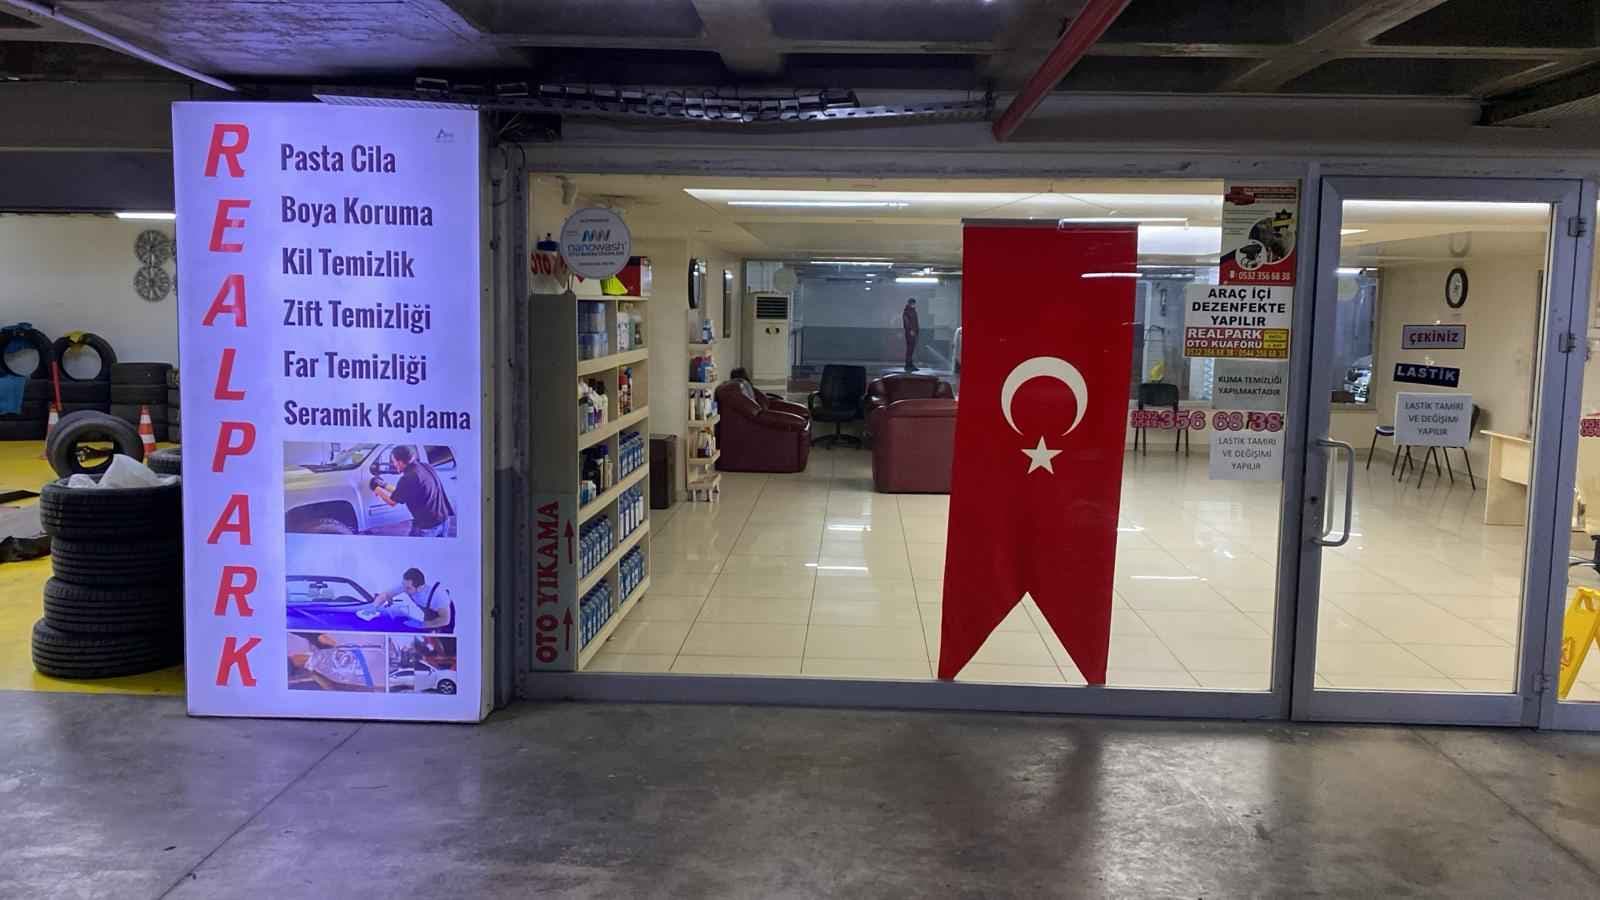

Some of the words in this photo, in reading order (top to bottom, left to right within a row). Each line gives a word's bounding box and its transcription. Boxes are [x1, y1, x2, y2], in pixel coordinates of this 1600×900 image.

[280, 144, 344, 172] Pasta
[351, 144, 396, 173] Cila
[281, 195, 337, 228] Boya
[343, 197, 433, 226] Koruma
[281, 247, 312, 275] Kil
[318, 248, 415, 278] Temizlik
[1208, 288, 1247, 301] ARAÇ
[1252, 287, 1271, 301] İÇİ
[1192, 302, 1286, 313] DEZENFEKTE
[283, 299, 323, 327] Zift
[328, 300, 431, 334] Temizliği
[1211, 316, 1266, 326] YAPILIR
[1187, 328, 1262, 339] REALPARK
[1409, 330, 1459, 345] ÇEKİNİZ
[1186, 340, 1209, 348] OTO
[283, 350, 318, 378] Far
[324, 352, 427, 385] Temizliği
[1396, 366, 1456, 381] LASTİK
[202, 122, 262, 687] REALPARK
[284, 400, 371, 427] Seramik
[377, 403, 471, 433] Kaplama
[1408, 415, 1420, 423] VE
[1417, 427, 1448, 436] YAPILIR
[1222, 448, 1232, 457] VE
[1231, 462, 1261, 471] YAPILIR
[536, 500, 560, 607] YIKAMA
[535, 614, 560, 663] OTO
